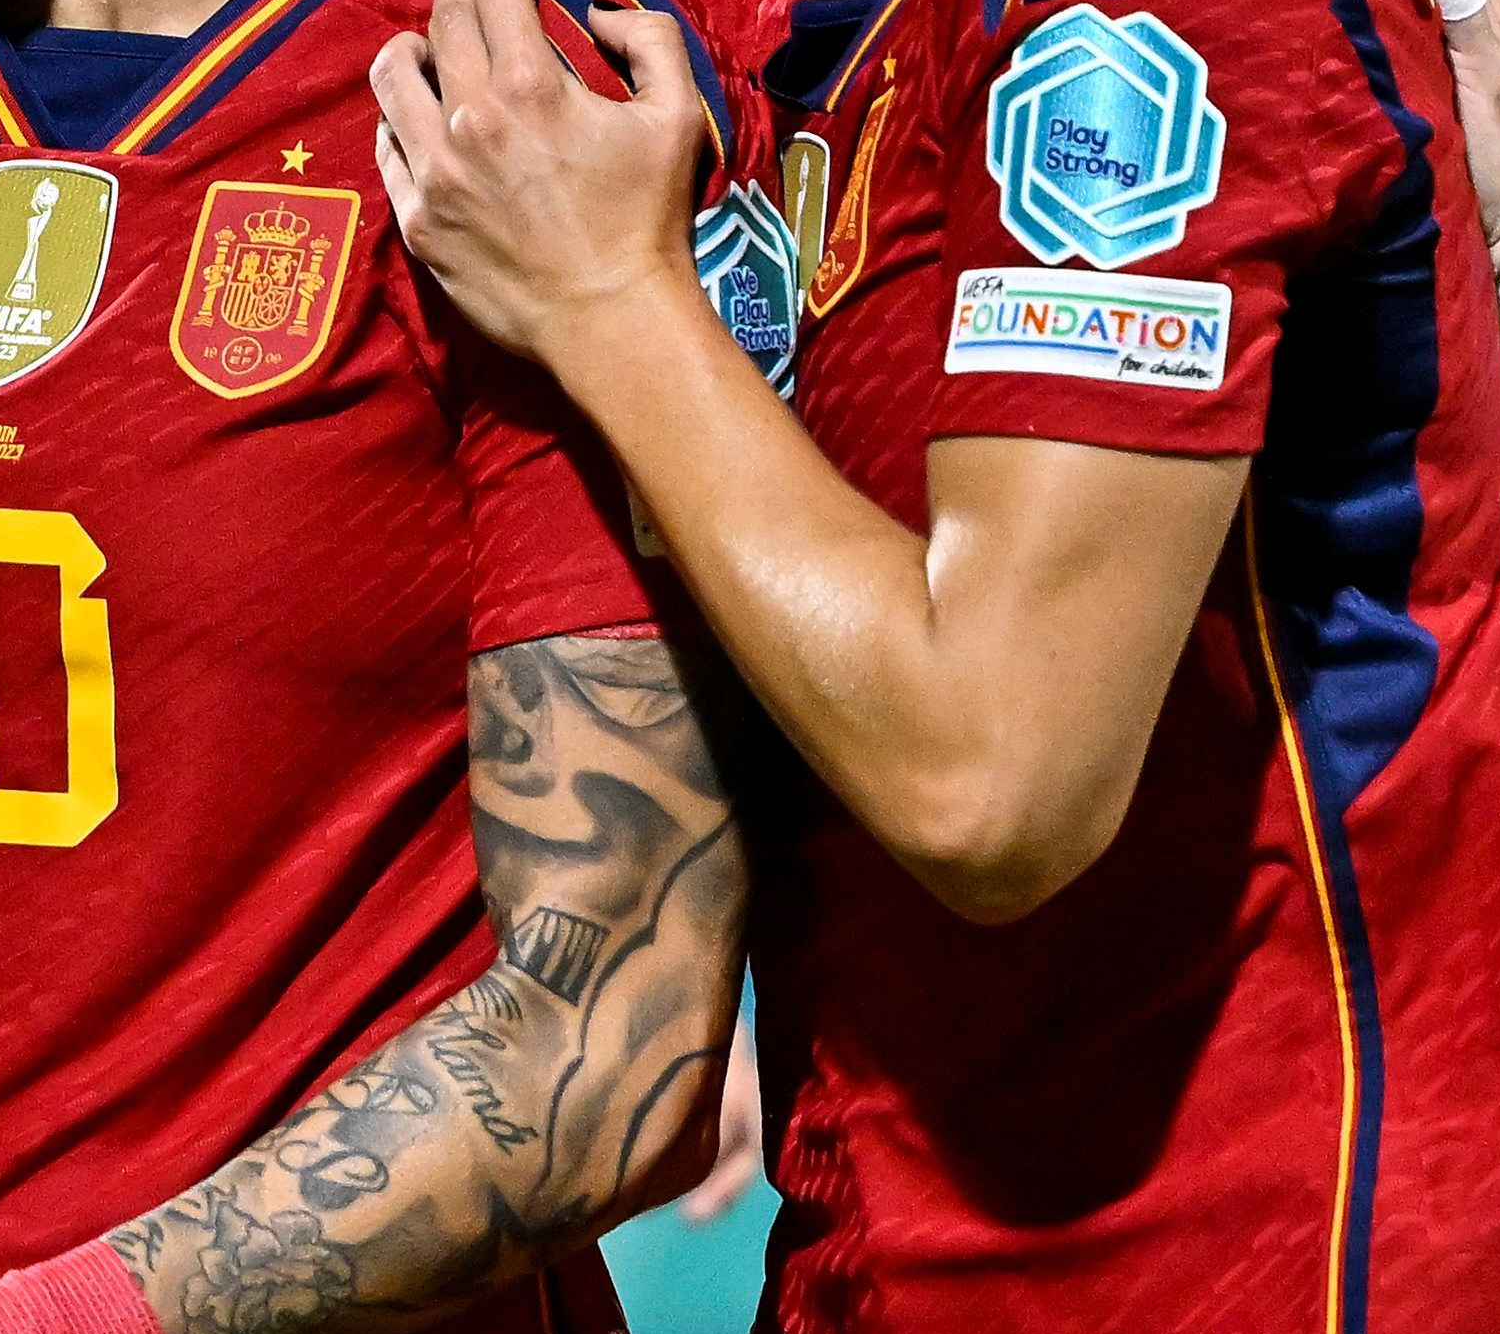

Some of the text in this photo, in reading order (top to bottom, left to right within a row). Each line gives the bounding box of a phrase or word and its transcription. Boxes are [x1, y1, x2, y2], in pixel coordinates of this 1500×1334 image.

[1049, 118, 1110, 154] Play
[1045, 148, 1140, 187] Strong
[730, 268, 758, 294] We
[962, 276, 1005, 299] UEFA
[732, 296, 771, 324] Play
[734, 325, 791, 355] Strong
[957, 301, 1220, 354] FOUNDATION
